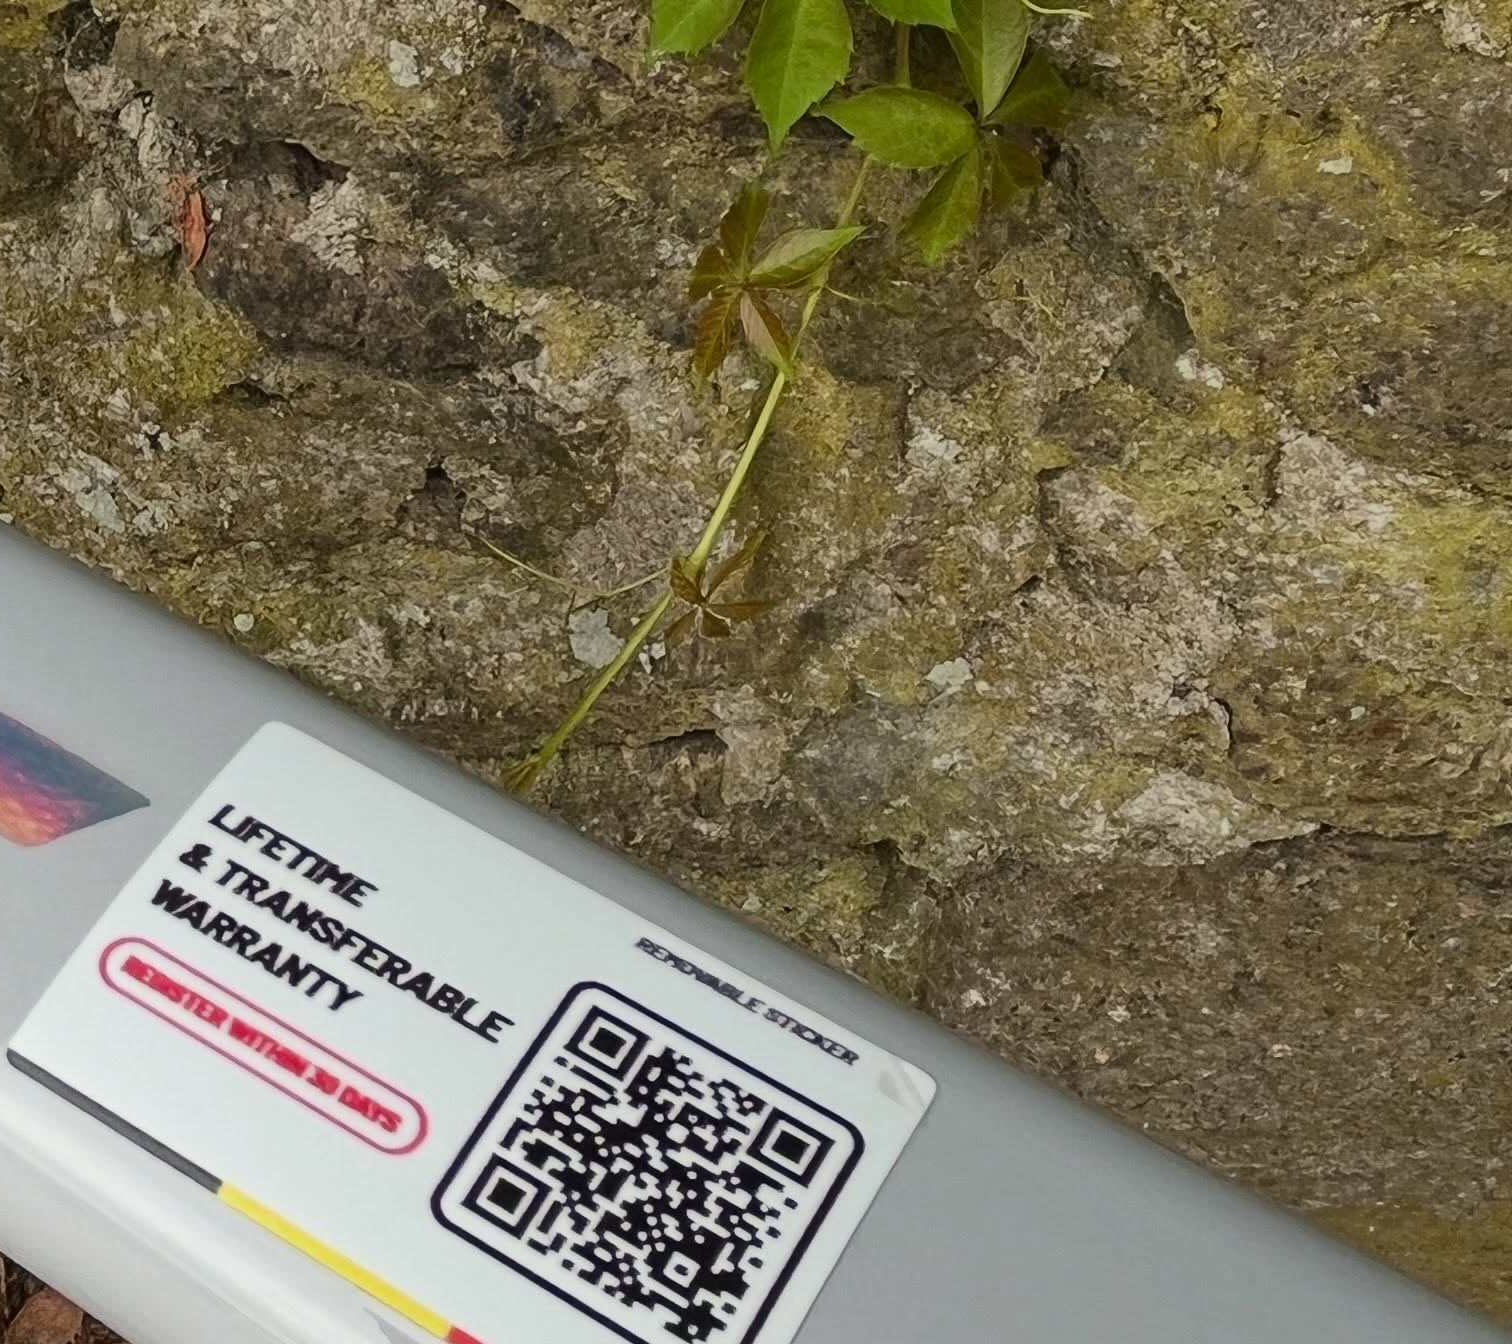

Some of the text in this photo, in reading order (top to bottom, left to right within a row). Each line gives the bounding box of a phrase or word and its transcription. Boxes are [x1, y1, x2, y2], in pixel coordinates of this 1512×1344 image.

[208, 804, 380, 908] LIFETIME
[151, 878, 364, 1012] WARRANTY
[178, 843, 515, 1044] & TRANSFERABLE
[120, 954, 230, 1029] REGISTER
[227, 1016, 309, 1078] WITHIN
[338, 1085, 403, 1133] DAYS
